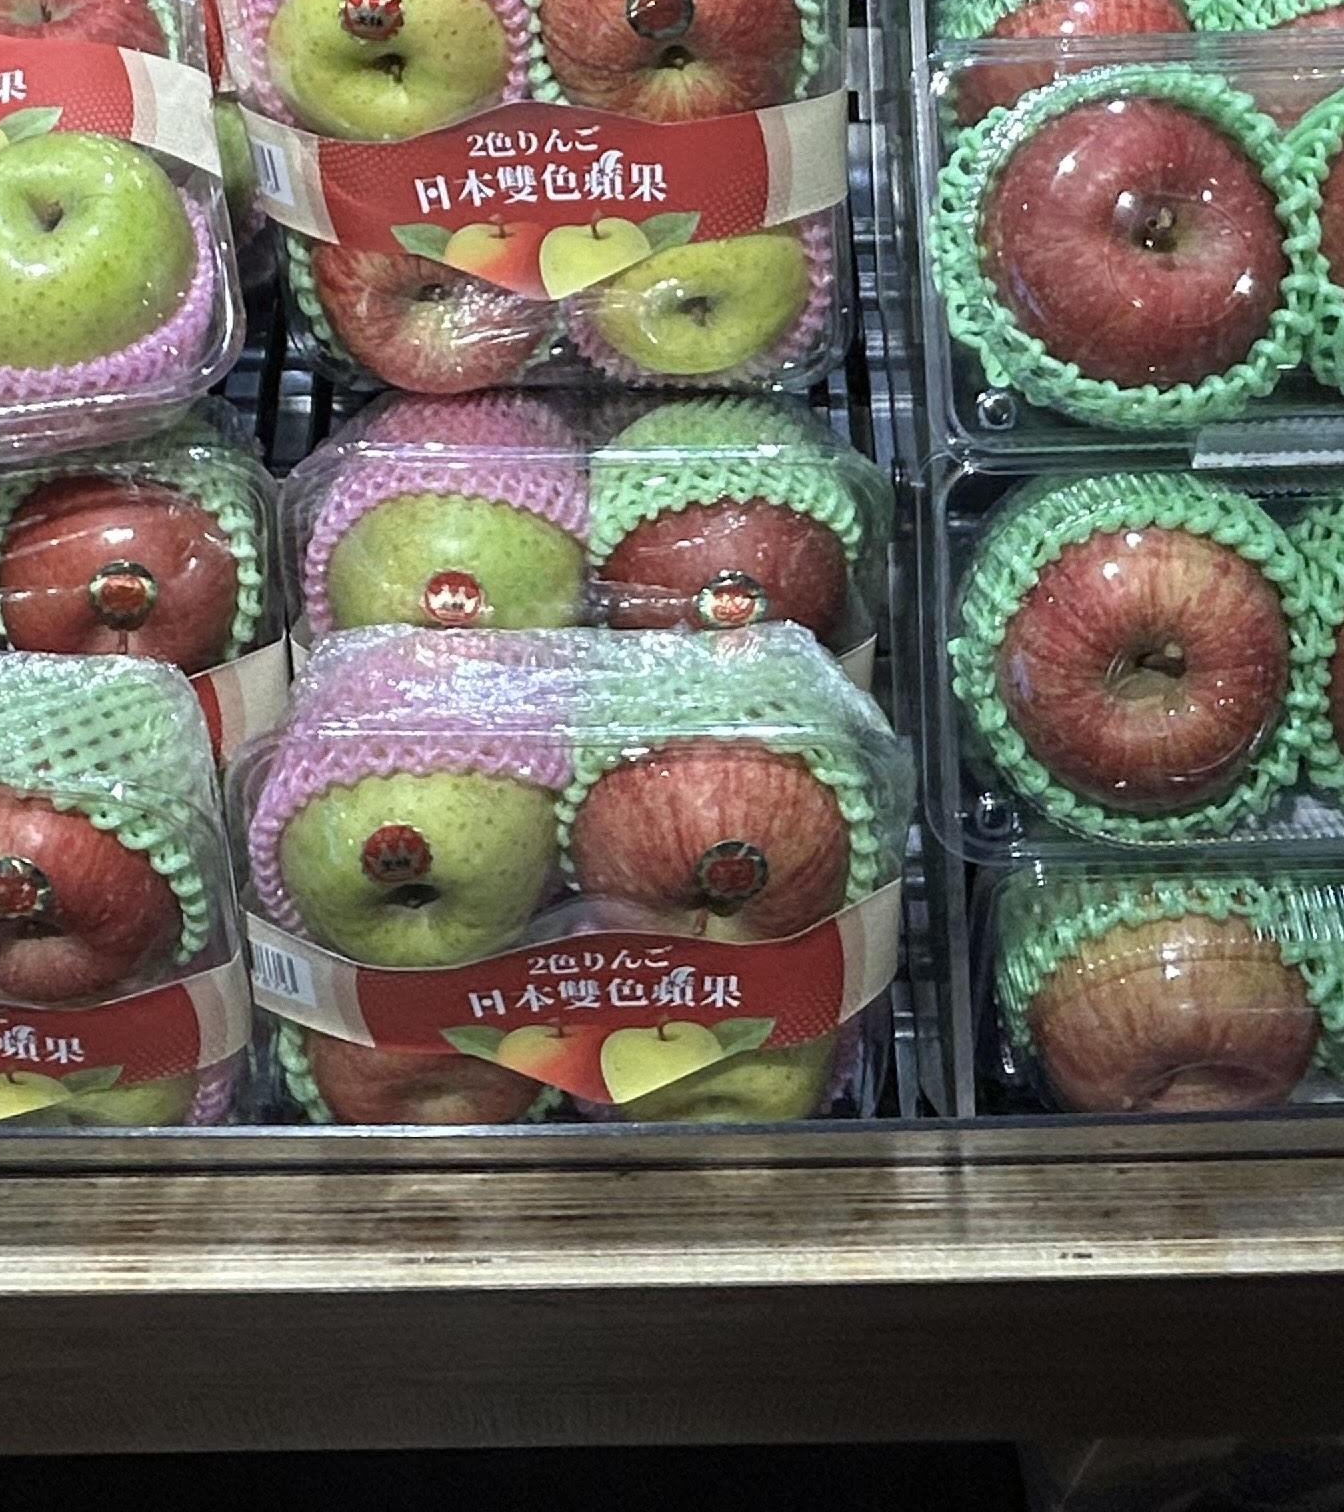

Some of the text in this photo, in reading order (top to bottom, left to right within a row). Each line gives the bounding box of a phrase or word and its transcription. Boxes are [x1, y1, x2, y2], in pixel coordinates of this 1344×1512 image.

[466, 125, 600, 157] 2色りんご
[413, 150, 667, 213] 日本雙色蘋果
[527, 945, 674, 975] 2色りんご
[467, 966, 742, 1018] 日本雙色蘋果
